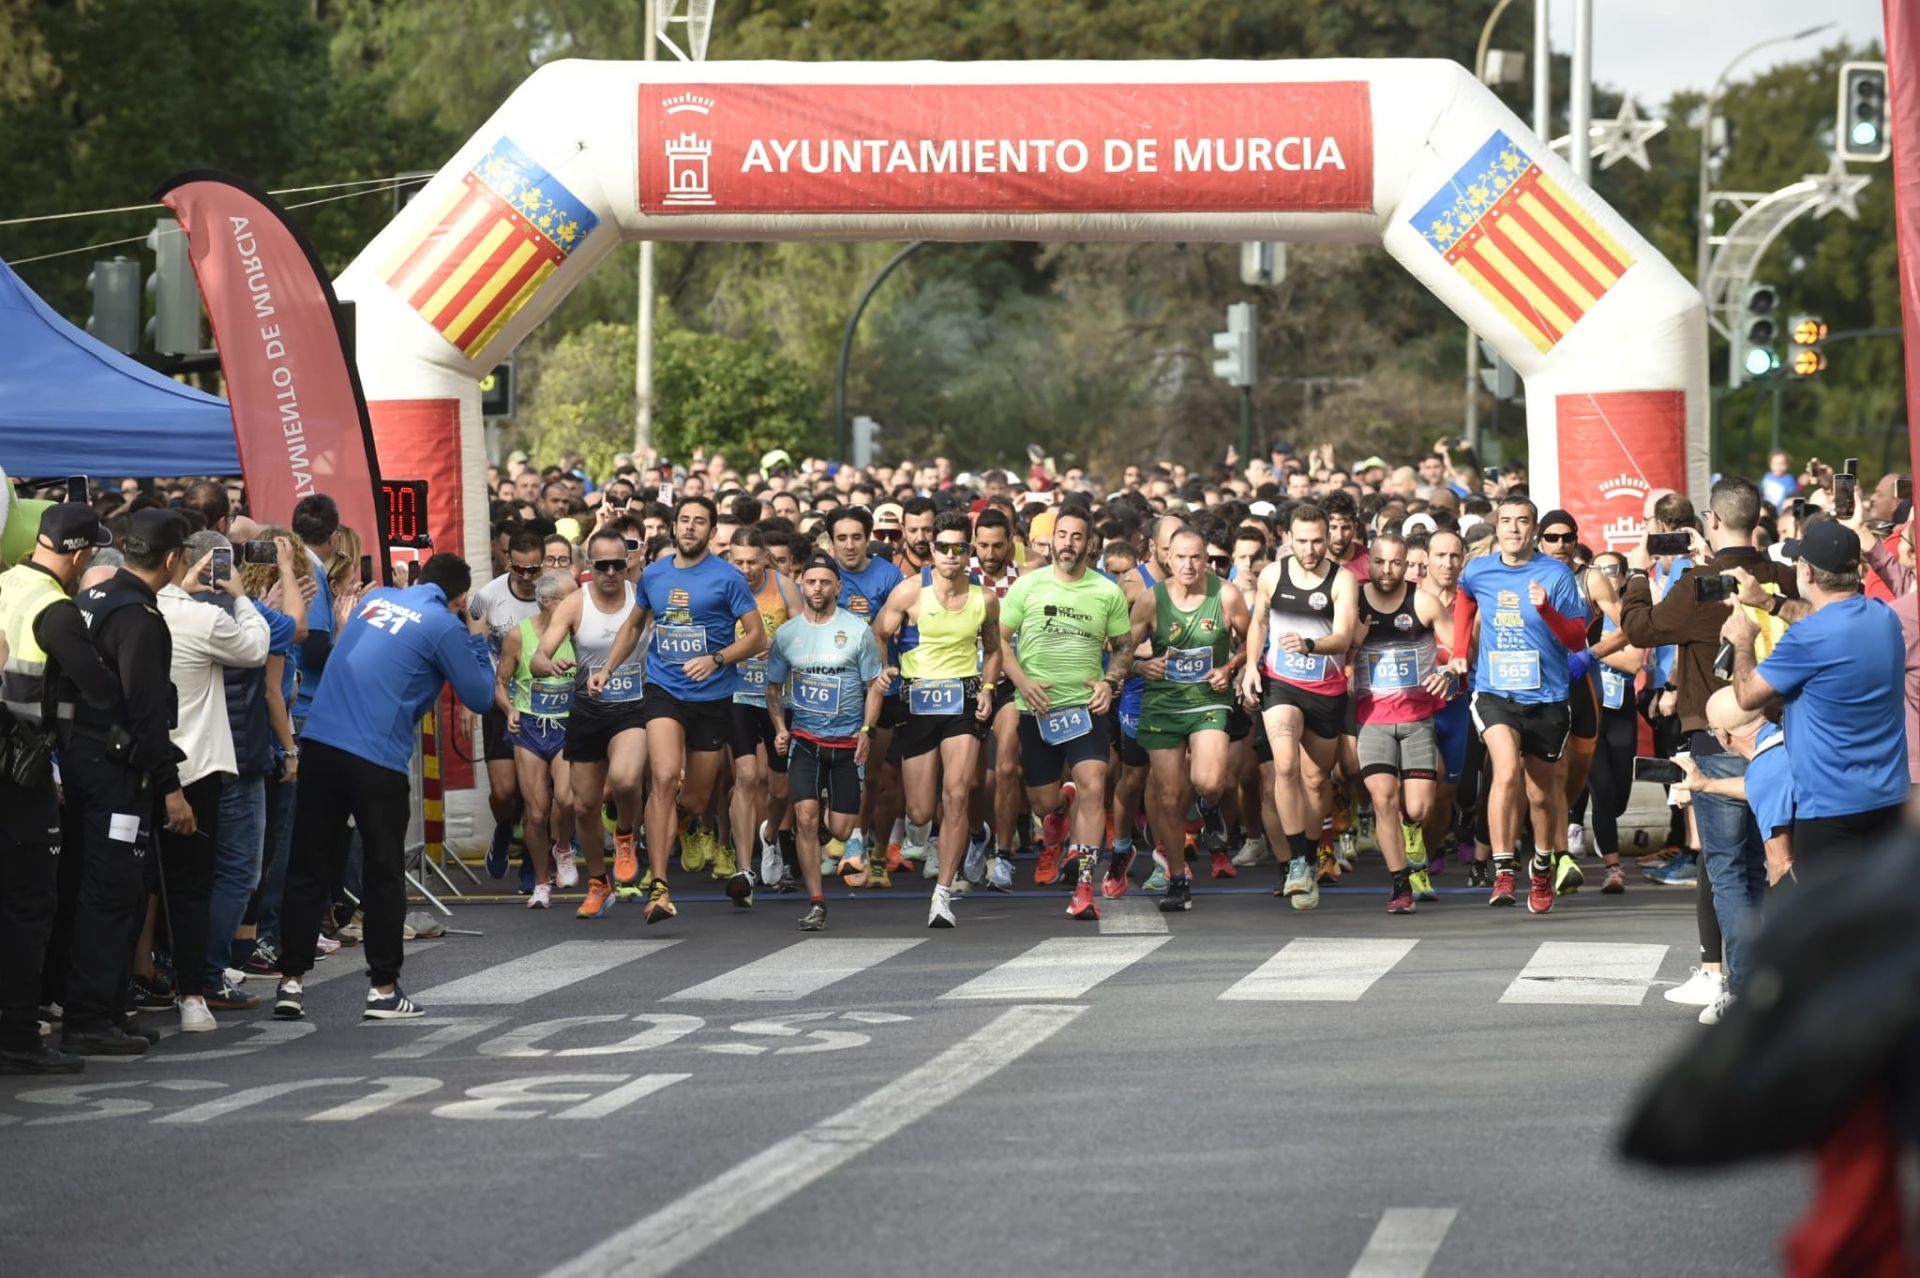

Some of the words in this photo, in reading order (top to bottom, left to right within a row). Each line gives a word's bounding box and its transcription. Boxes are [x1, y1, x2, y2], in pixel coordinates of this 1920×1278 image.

[741, 137, 1089, 175] AYUNTAMIENTO
[1102, 137, 1158, 172] DE
[1172, 136, 1347, 172] MURCIA
[366, 609, 408, 635] 21
[661, 638, 703, 652] 4106
[1175, 659, 1204, 672] 649
[1284, 654, 1316, 670] 248
[743, 670, 767, 684] 48
[1376, 663, 1409, 677] 025
[1498, 664, 1530, 677] 565
[539, 693, 569, 706] 779
[799, 685, 830, 701] 176
[920, 689, 953, 703] 701
[1049, 712, 1082, 733] 514
